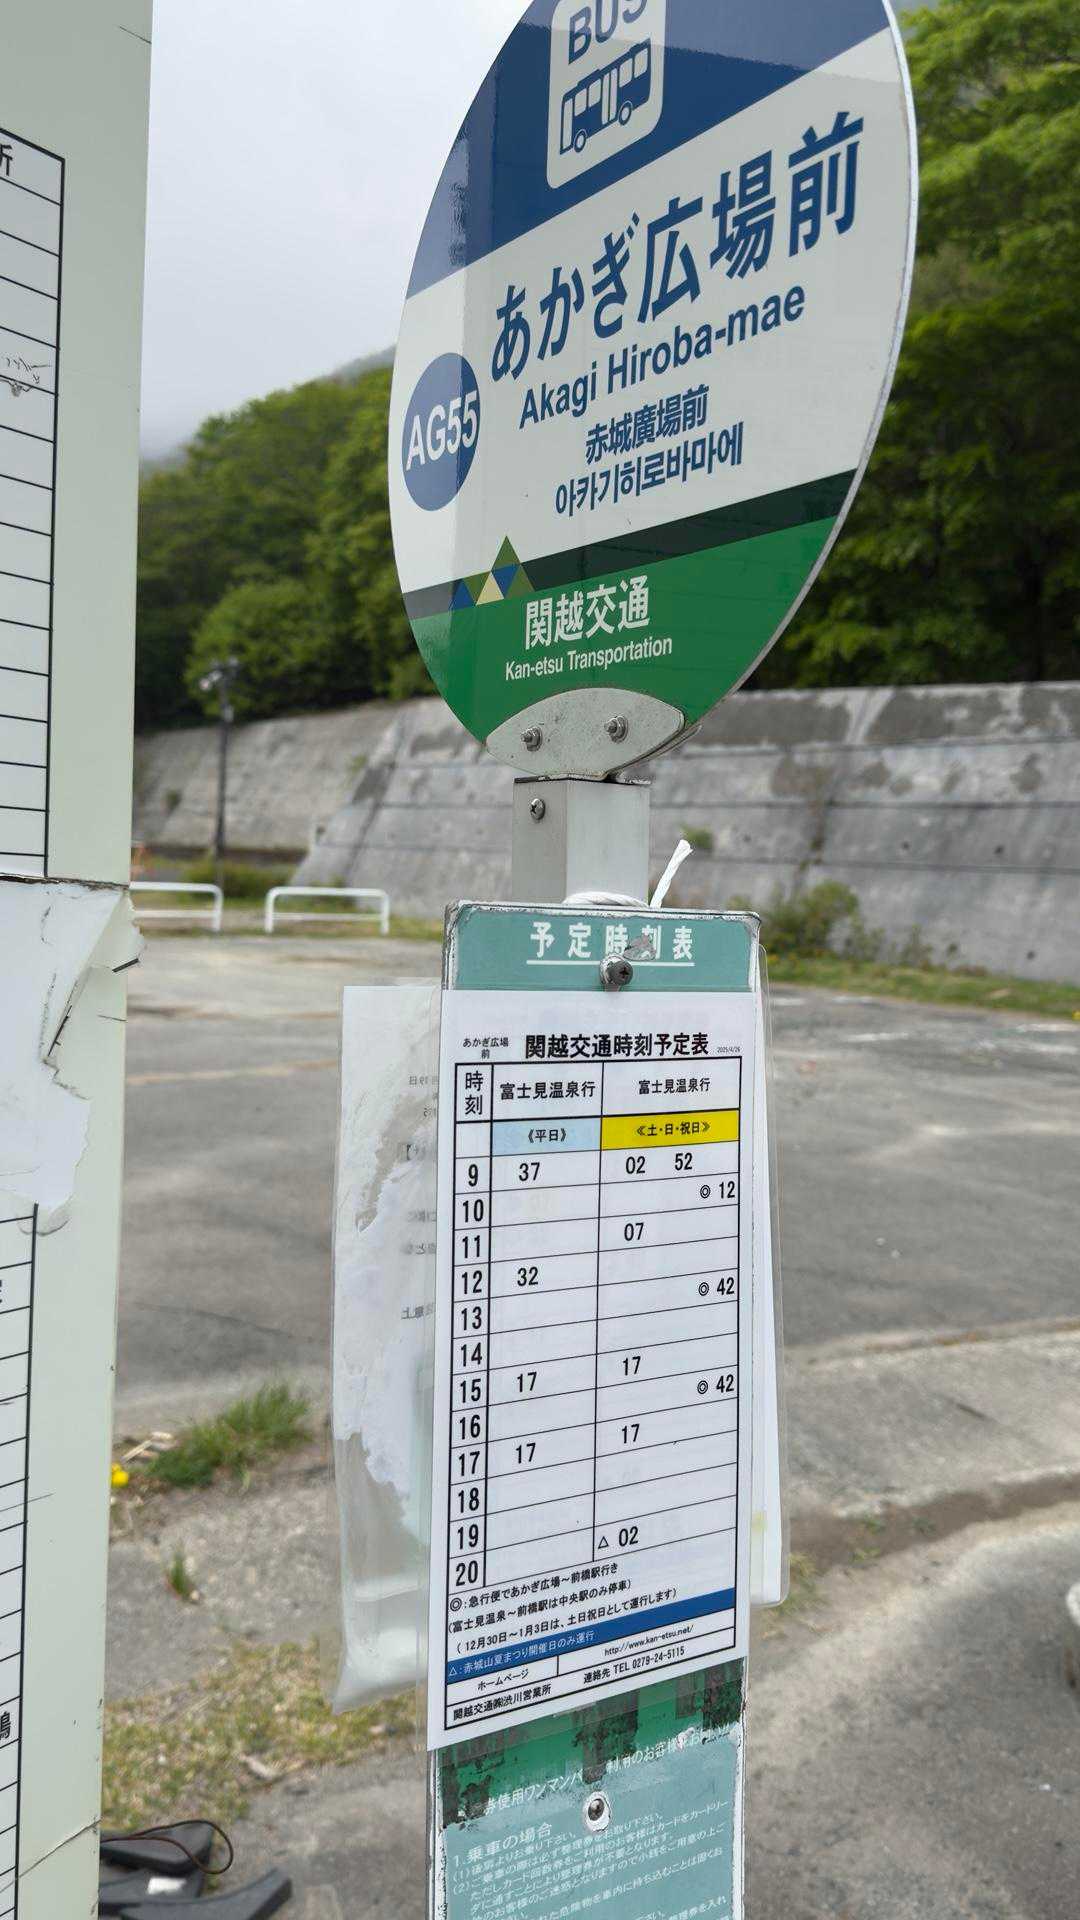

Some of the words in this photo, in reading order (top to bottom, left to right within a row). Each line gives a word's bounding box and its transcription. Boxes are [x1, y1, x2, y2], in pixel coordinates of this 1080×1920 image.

[490, 111, 864, 383] あかぎ広場前
[519, 370, 597, 429] Akagi
[607, 286, 806, 394] Hiroba-mae
[405, 390, 478, 471] AG55
[585, 384, 709, 465] 赤城廣場前
[555, 421, 744, 517] 아카기히로바마에
[525, 575, 650, 649] 関越交通
[505, 657, 563, 680] Kan-etsu
[567, 636, 673, 671] Transportation
[463, 1037, 510, 1048] あかぎ広場
[481, 1048, 490, 1060] 前
[525, 1032, 709, 1059] 関越交通時刻予定表
[465, 1070, 484, 1115] 時刻
[500, 1081, 596, 1100] 富士見温泉行
[639, 1077, 710, 1095] 富士見温泉行
[468, 1163, 479, 1188] 9
[518, 1161, 541, 1182] 37
[625, 1155, 646, 1175] 02
[674, 1152, 693, 1171] 52
[718, 1180, 736, 1199] 12
[462, 1198, 484, 1223] 10
[623, 1222, 644, 1242] 07
[462, 1234, 481, 1259] 11
[461, 1270, 483, 1295] 12
[517, 1266, 539, 1287] 32
[716, 1276, 735, 1296] 42
[461, 1306, 482, 1331] 13
[460, 1342, 483, 1367] 14
[622, 1355, 641, 1376] 17
[459, 1378, 482, 1404] 15
[516, 1371, 538, 1393] 17
[715, 1373, 735, 1394] 42
[459, 1414, 481, 1440] 16
[621, 1423, 640, 1444] 17
[458, 1450, 481, 1477] 17
[515, 1442, 536, 1465] 17
[457, 1487, 480, 1514] 18
[456, 1523, 480, 1550] 19
[617, 1525, 640, 1548] 02
[455, 1560, 479, 1587] 20
[604, 1625, 694, 1657] http://www.kan-etsu.net/
[613, 1662, 630, 1674] TEL
[632, 1646, 685, 1669] 0279-24-5115
[477, 1668, 529, 1691] ホームページ
